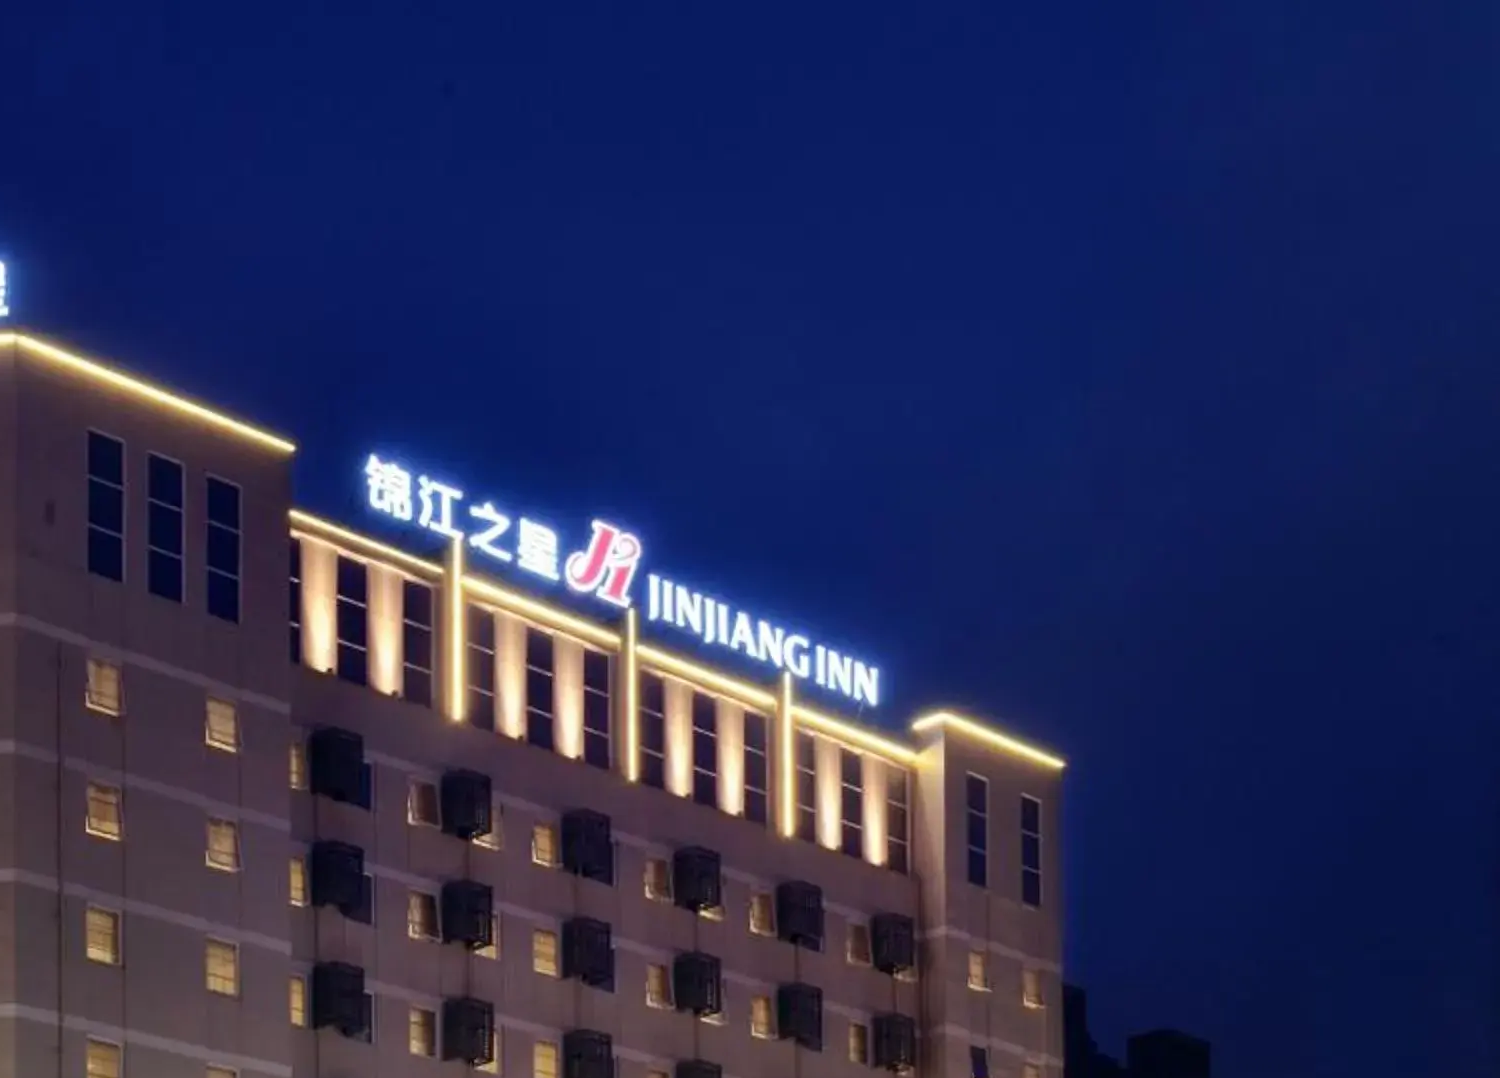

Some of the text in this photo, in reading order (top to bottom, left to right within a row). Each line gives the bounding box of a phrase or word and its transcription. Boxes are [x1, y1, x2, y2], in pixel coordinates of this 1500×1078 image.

[364, 453, 560, 582] 锦江之星
[648, 574, 880, 707] JINJIANG INN
